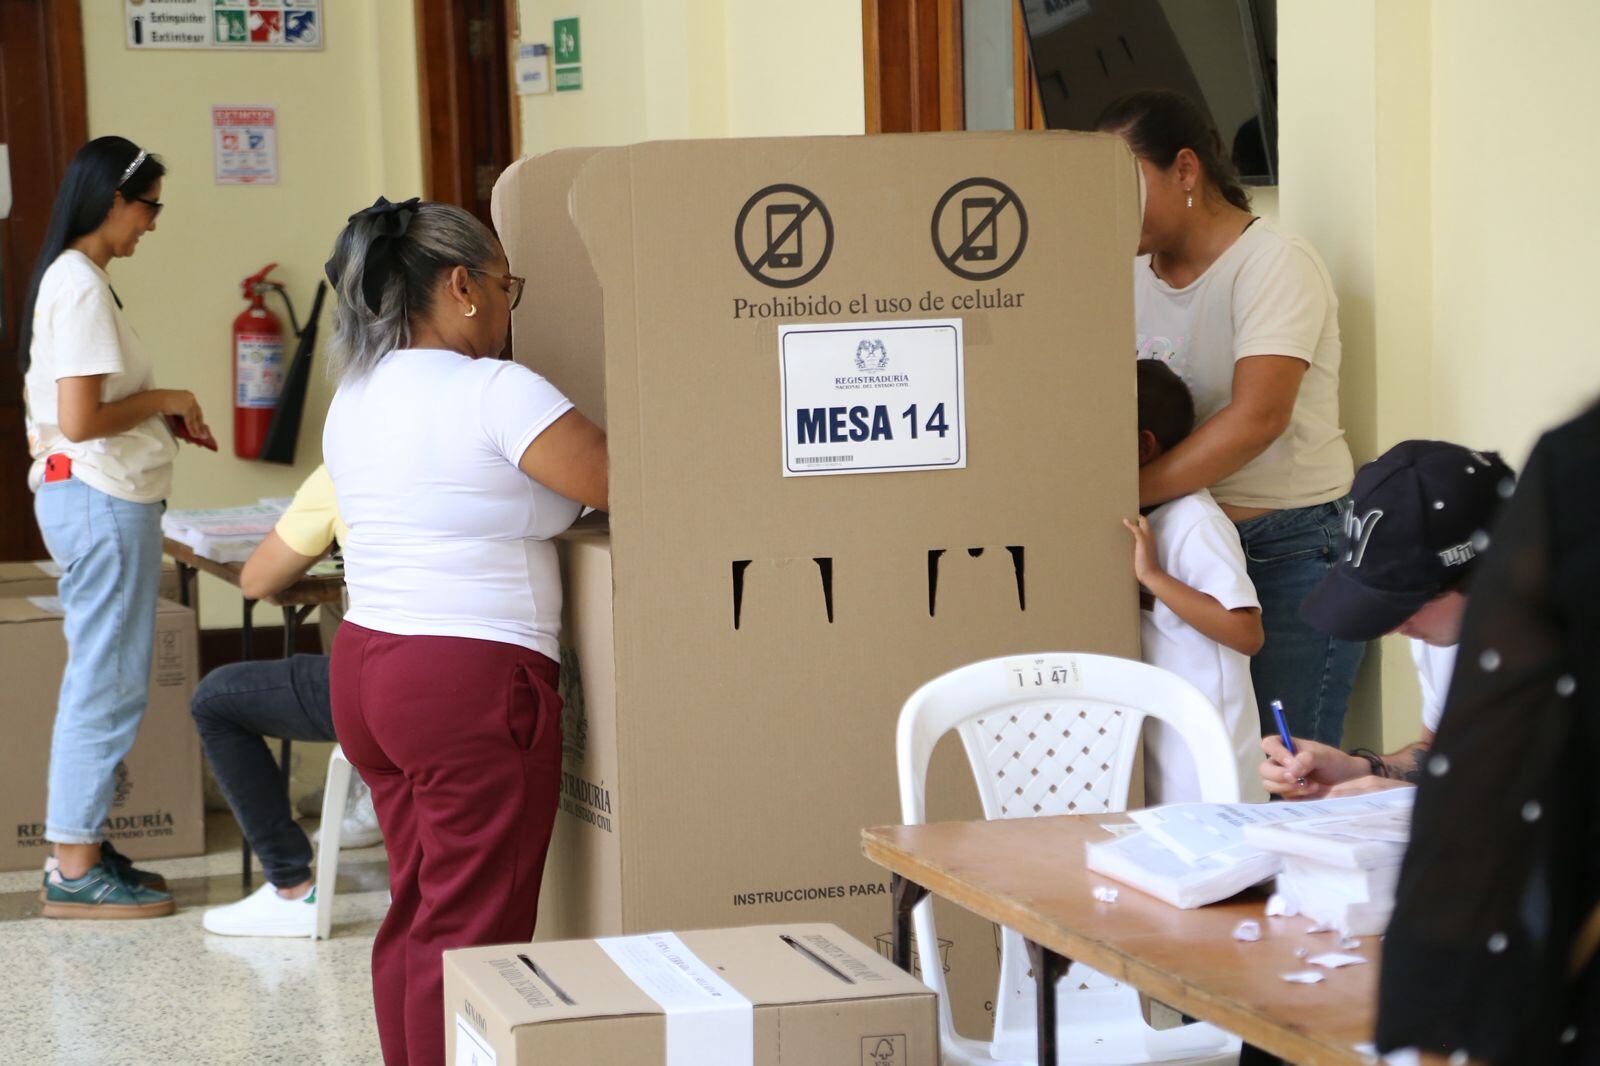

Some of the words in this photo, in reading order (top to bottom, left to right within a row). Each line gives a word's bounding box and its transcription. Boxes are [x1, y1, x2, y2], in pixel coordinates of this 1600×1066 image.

[733, 296, 842, 319] Prohibido
[849, 294, 867, 314] el
[875, 297, 912, 313] uso
[919, 291, 944, 311] de
[951, 288, 1025, 310] celular
[835, 374, 910, 385] REGISTRADURÍA
[796, 405, 893, 445] MESA
[902, 402, 949, 440] 14
[1051, 669, 1068, 685] 47
[733, 885, 846, 906] INSTRUCCIONES
[850, 882, 886, 897] PARA
